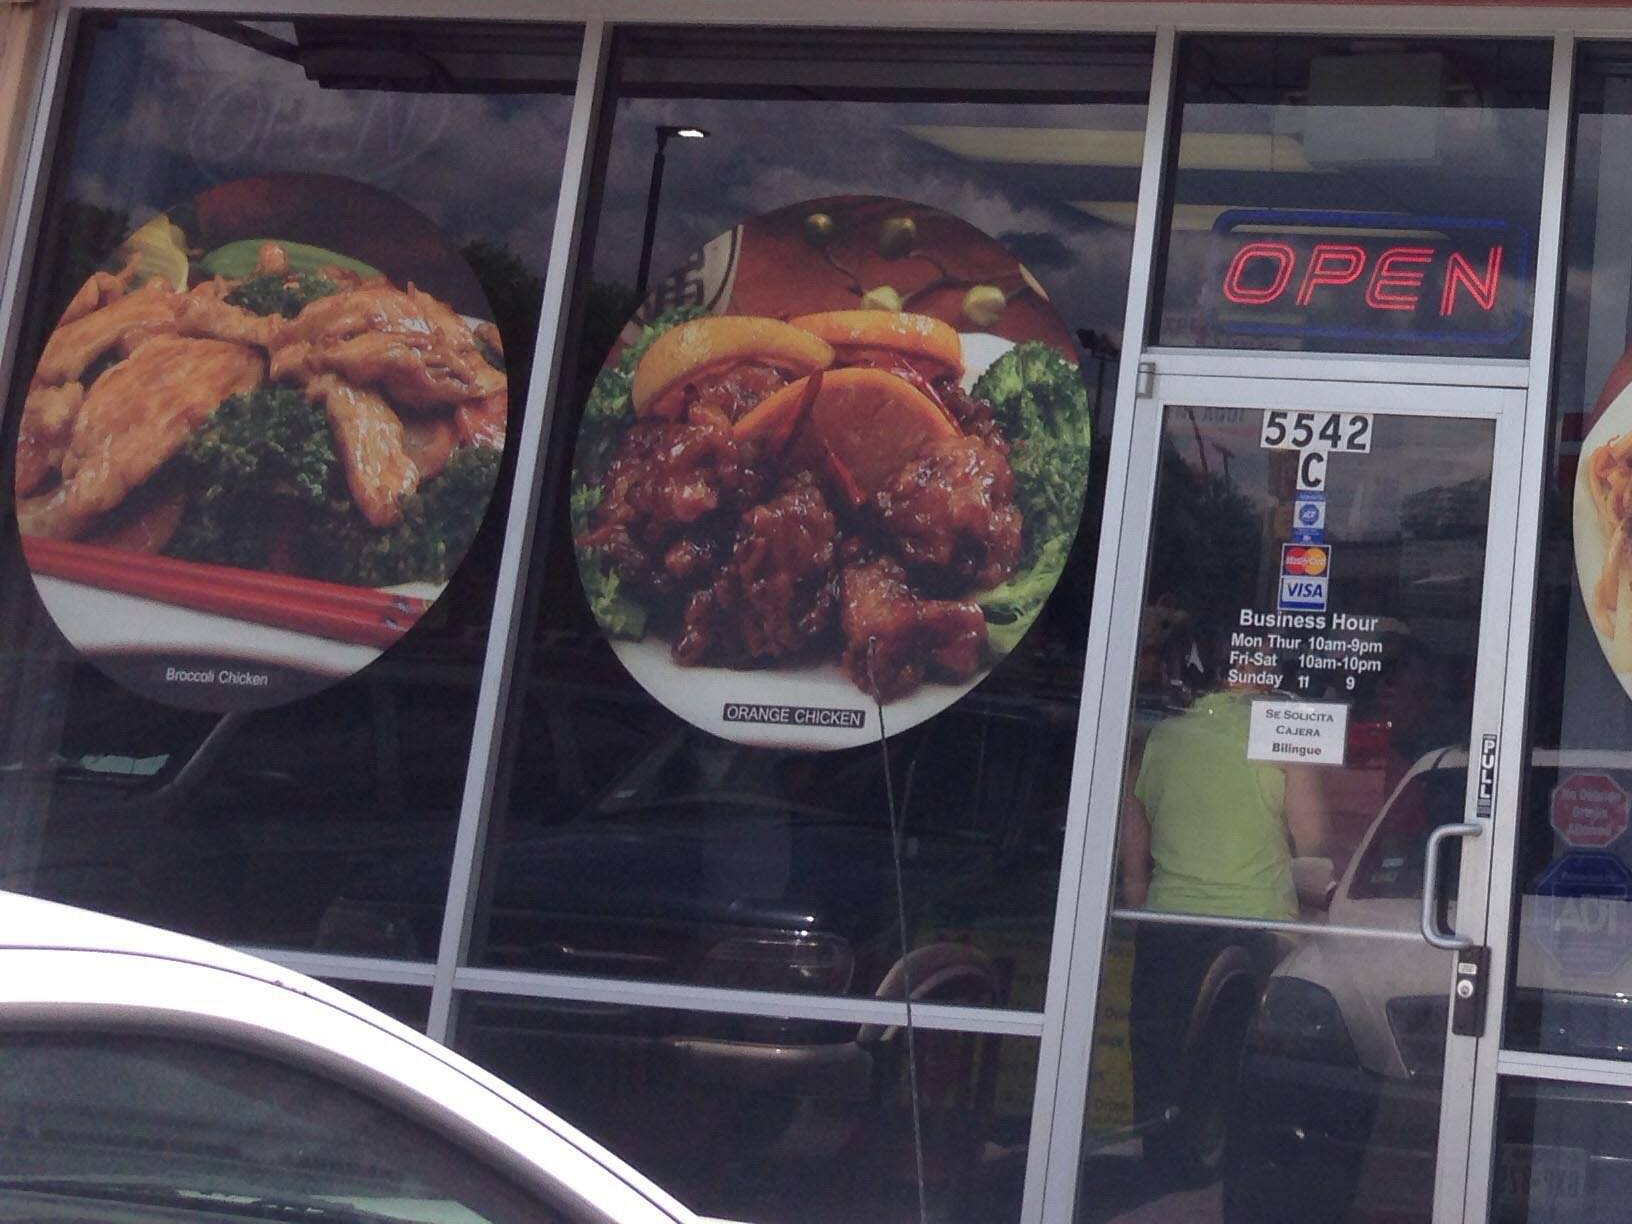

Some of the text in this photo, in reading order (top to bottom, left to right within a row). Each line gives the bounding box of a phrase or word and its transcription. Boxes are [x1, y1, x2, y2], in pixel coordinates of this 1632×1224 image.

[1222, 241, 1503, 316] OPEN
[1264, 410, 1370, 451] 5542
[1300, 451, 1324, 488] C
[1287, 582, 1323, 598] VISA
[1239, 608, 1379, 632] Business Hour
[1231, 632, 1383, 655] Mon Thur 10am-9pm
[1229, 651, 1382, 674] Fri-Sat 10am-10pm
[165, 666, 269, 686] Broccoli Chicken
[1227, 669, 1356, 690] Sunday 11 9
[726, 705, 862, 726] ORANGE CHICKEN
[1283, 710, 1335, 723] SOLICITA
[1275, 725, 1321, 737] CAJERA
[1271, 742, 1323, 757] Bilingue
[1480, 739, 1496, 799] PULL
